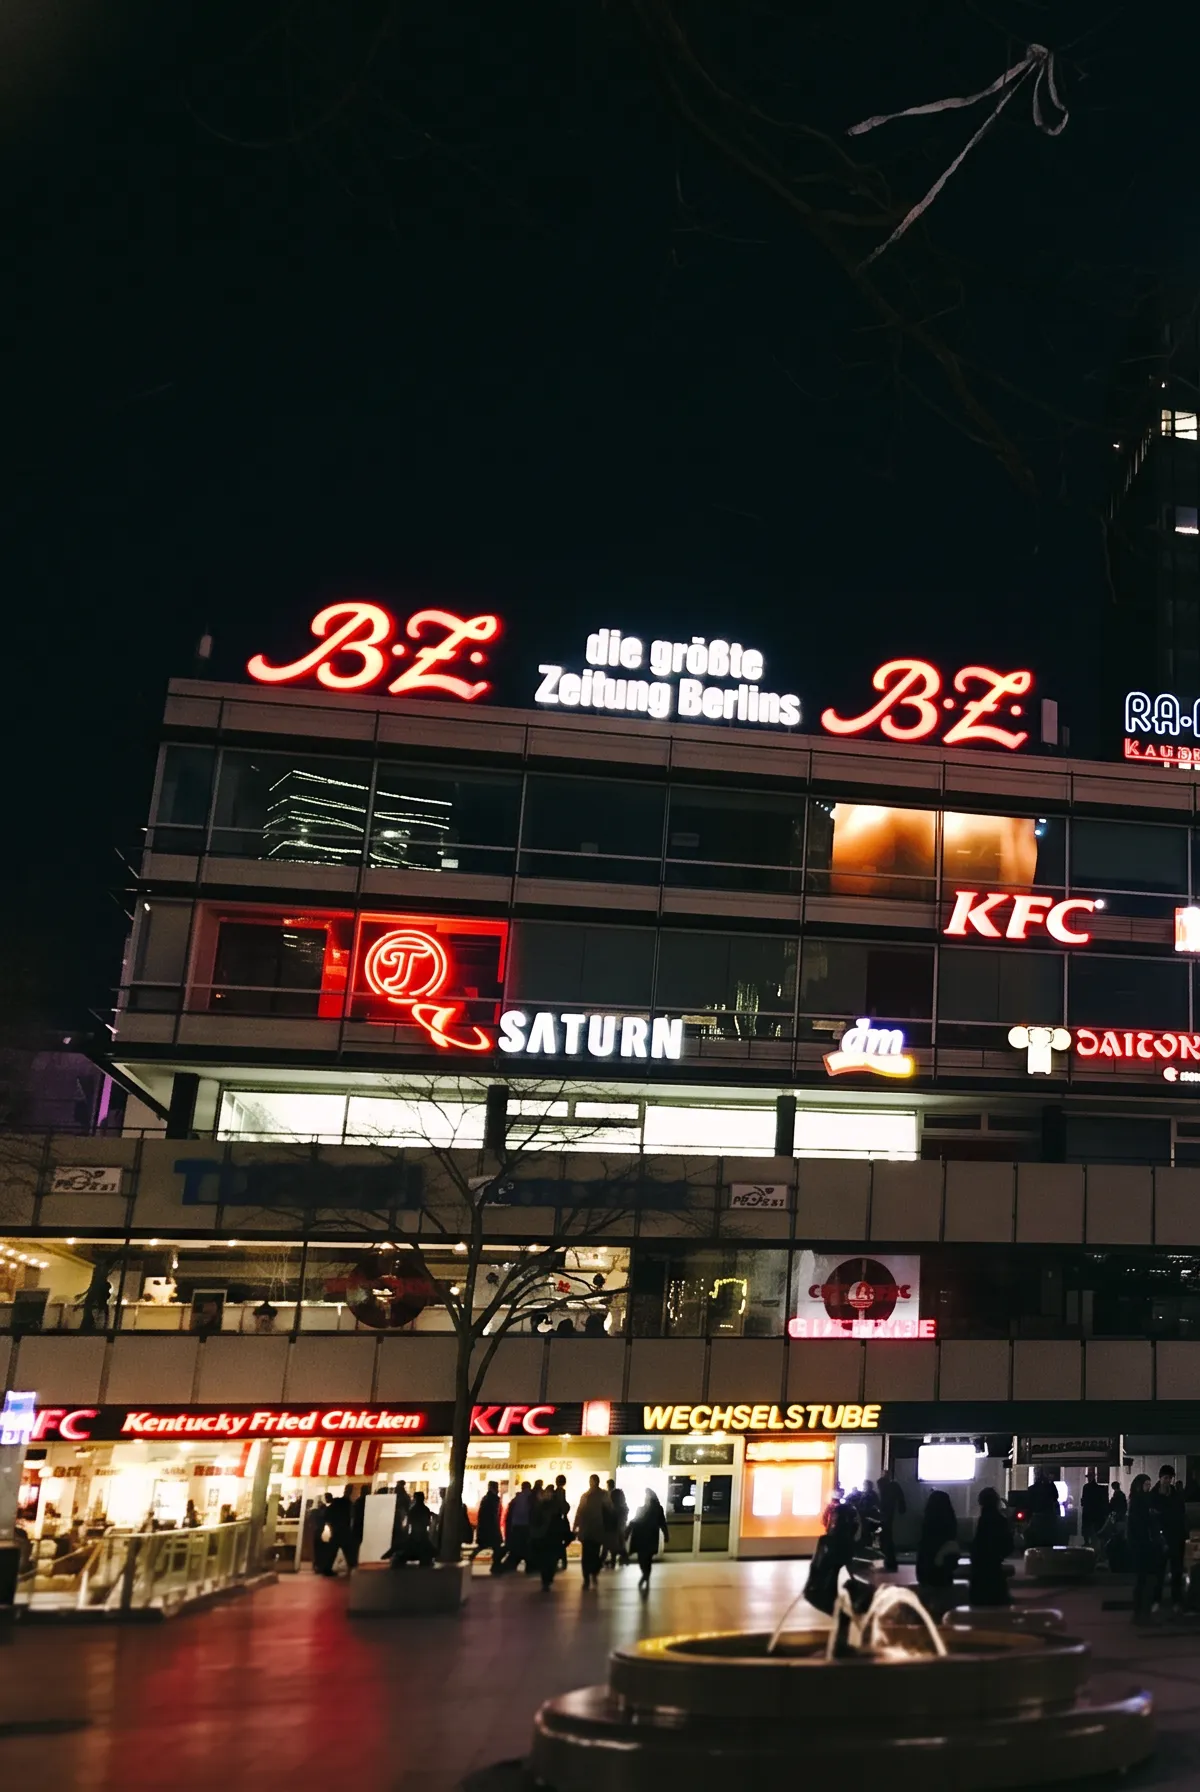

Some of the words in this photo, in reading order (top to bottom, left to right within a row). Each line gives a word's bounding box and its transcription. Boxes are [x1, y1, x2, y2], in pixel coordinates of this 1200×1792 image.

[586, 629, 643, 669] die
[650, 636, 764, 681] größte
[535, 664, 671, 719] Zeitung
[678, 678, 801, 727] Berlins
[943, 889, 1096, 945] KFC
[498, 1010, 682, 1060] SATURN
[842, 1018, 904, 1056] dm
[31, 1409, 98, 1440] FC
[121, 1412, 247, 1435] Kentucky
[248, 1411, 318, 1431] Fried
[321, 1410, 421, 1430] Chicken
[469, 1405, 556, 1435] KFC
[643, 1404, 882, 1430] WECHSELSTUBE
